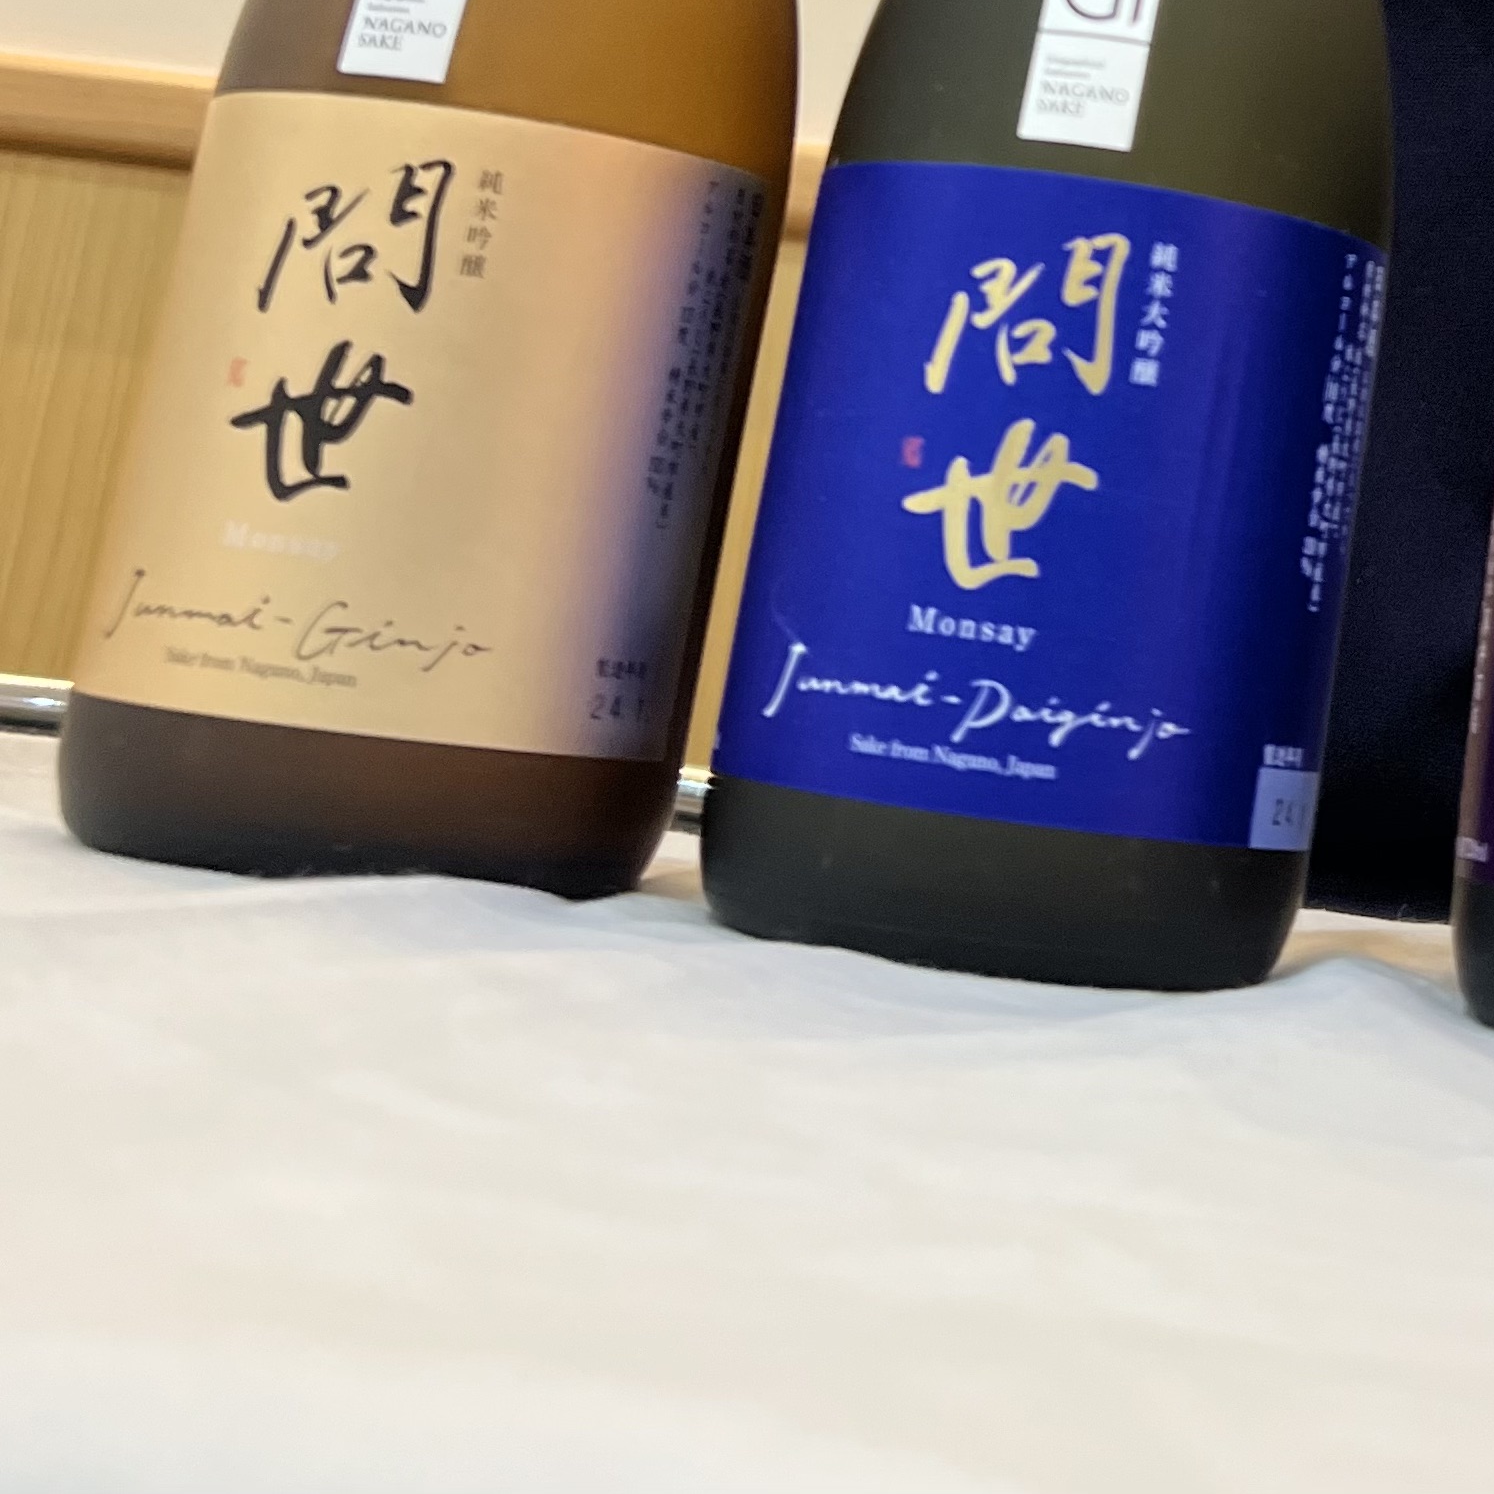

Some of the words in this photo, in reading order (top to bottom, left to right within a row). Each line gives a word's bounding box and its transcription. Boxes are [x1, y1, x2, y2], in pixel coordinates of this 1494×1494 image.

[362, 16, 447, 38] NAGANO
[357, 33, 403, 51] SAKE
[1040, 80, 1130, 104] NAGANO
[1036, 98, 1086, 117] SAKE
[105, 568, 492, 672] Junmai-Ginjo
[908, 605, 1037, 652] Monsay
[761, 642, 1191, 760] Junmai-Daiginjo
